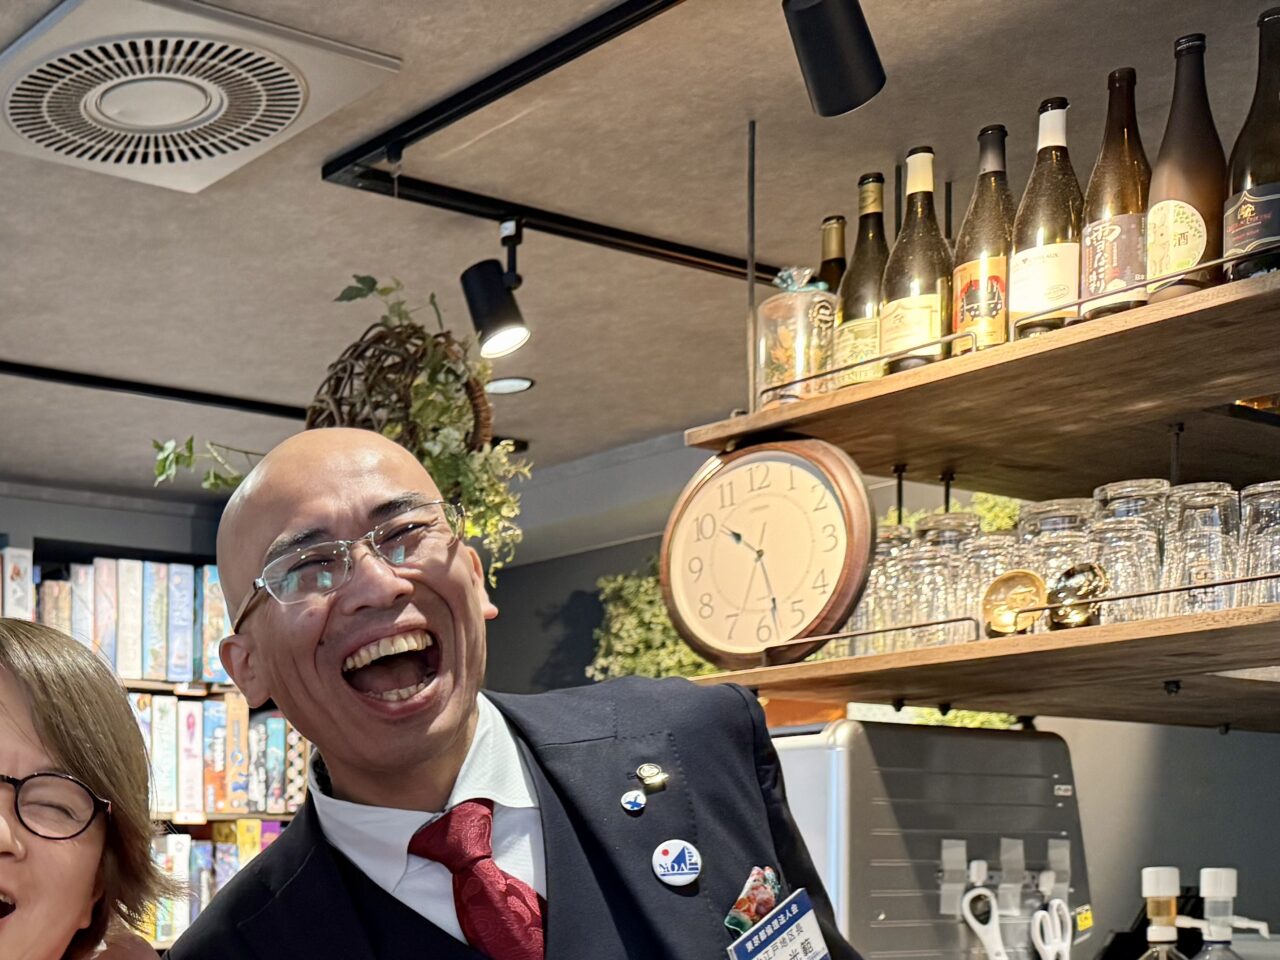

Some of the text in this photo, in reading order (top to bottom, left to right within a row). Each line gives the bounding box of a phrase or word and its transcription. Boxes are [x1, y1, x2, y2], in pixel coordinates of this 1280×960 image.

[746, 464, 772, 493] 12
[788, 464, 797, 491] 1
[718, 480, 736, 509] 11
[810, 485, 828, 512] 2
[693, 512, 717, 543] 10
[822, 524, 838, 552] 3
[688, 556, 704, 584] 9
[812, 568, 829, 595] 4
[698, 593, 714, 619] 8
[790, 599, 805, 629] 5
[725, 614, 740, 640] 7
[756, 614, 772, 643] 6
